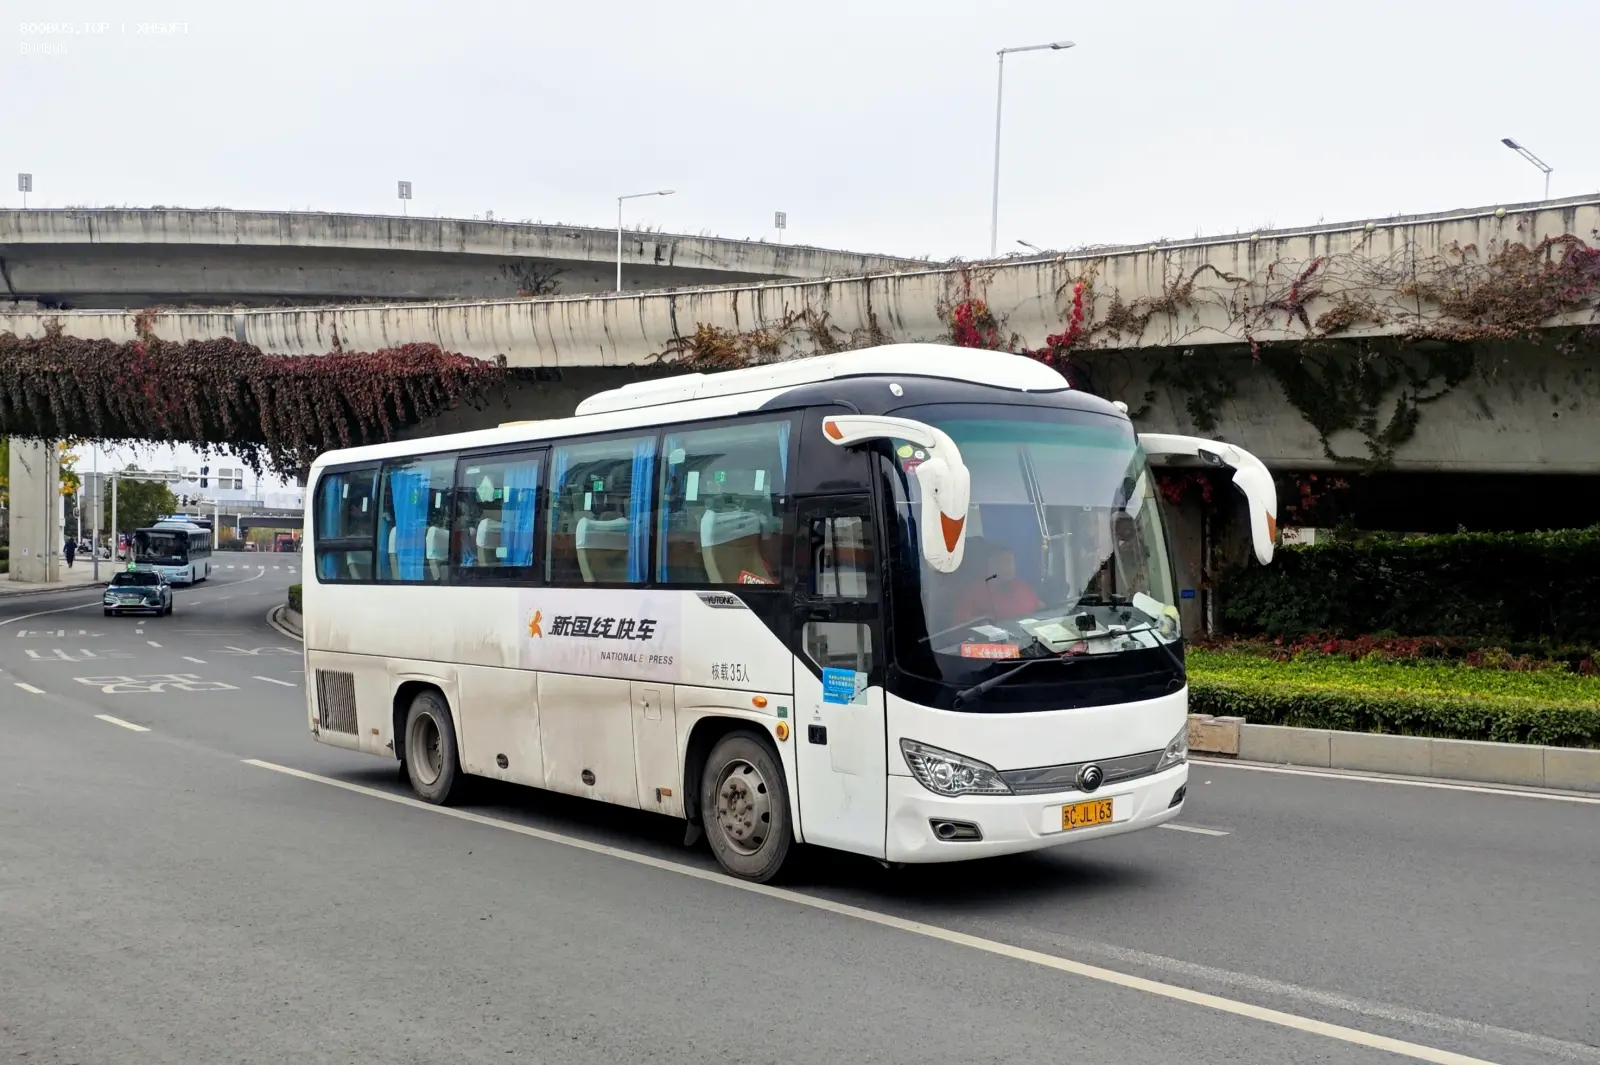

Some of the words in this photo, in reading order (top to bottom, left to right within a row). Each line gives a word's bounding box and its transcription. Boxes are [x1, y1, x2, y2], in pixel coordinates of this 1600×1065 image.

[707, 596, 734, 605] YUTONG
[548, 615, 657, 641] 新国线快车
[600, 651, 637, 663] NATIONAL
[711, 661, 750, 683] 核载35人
